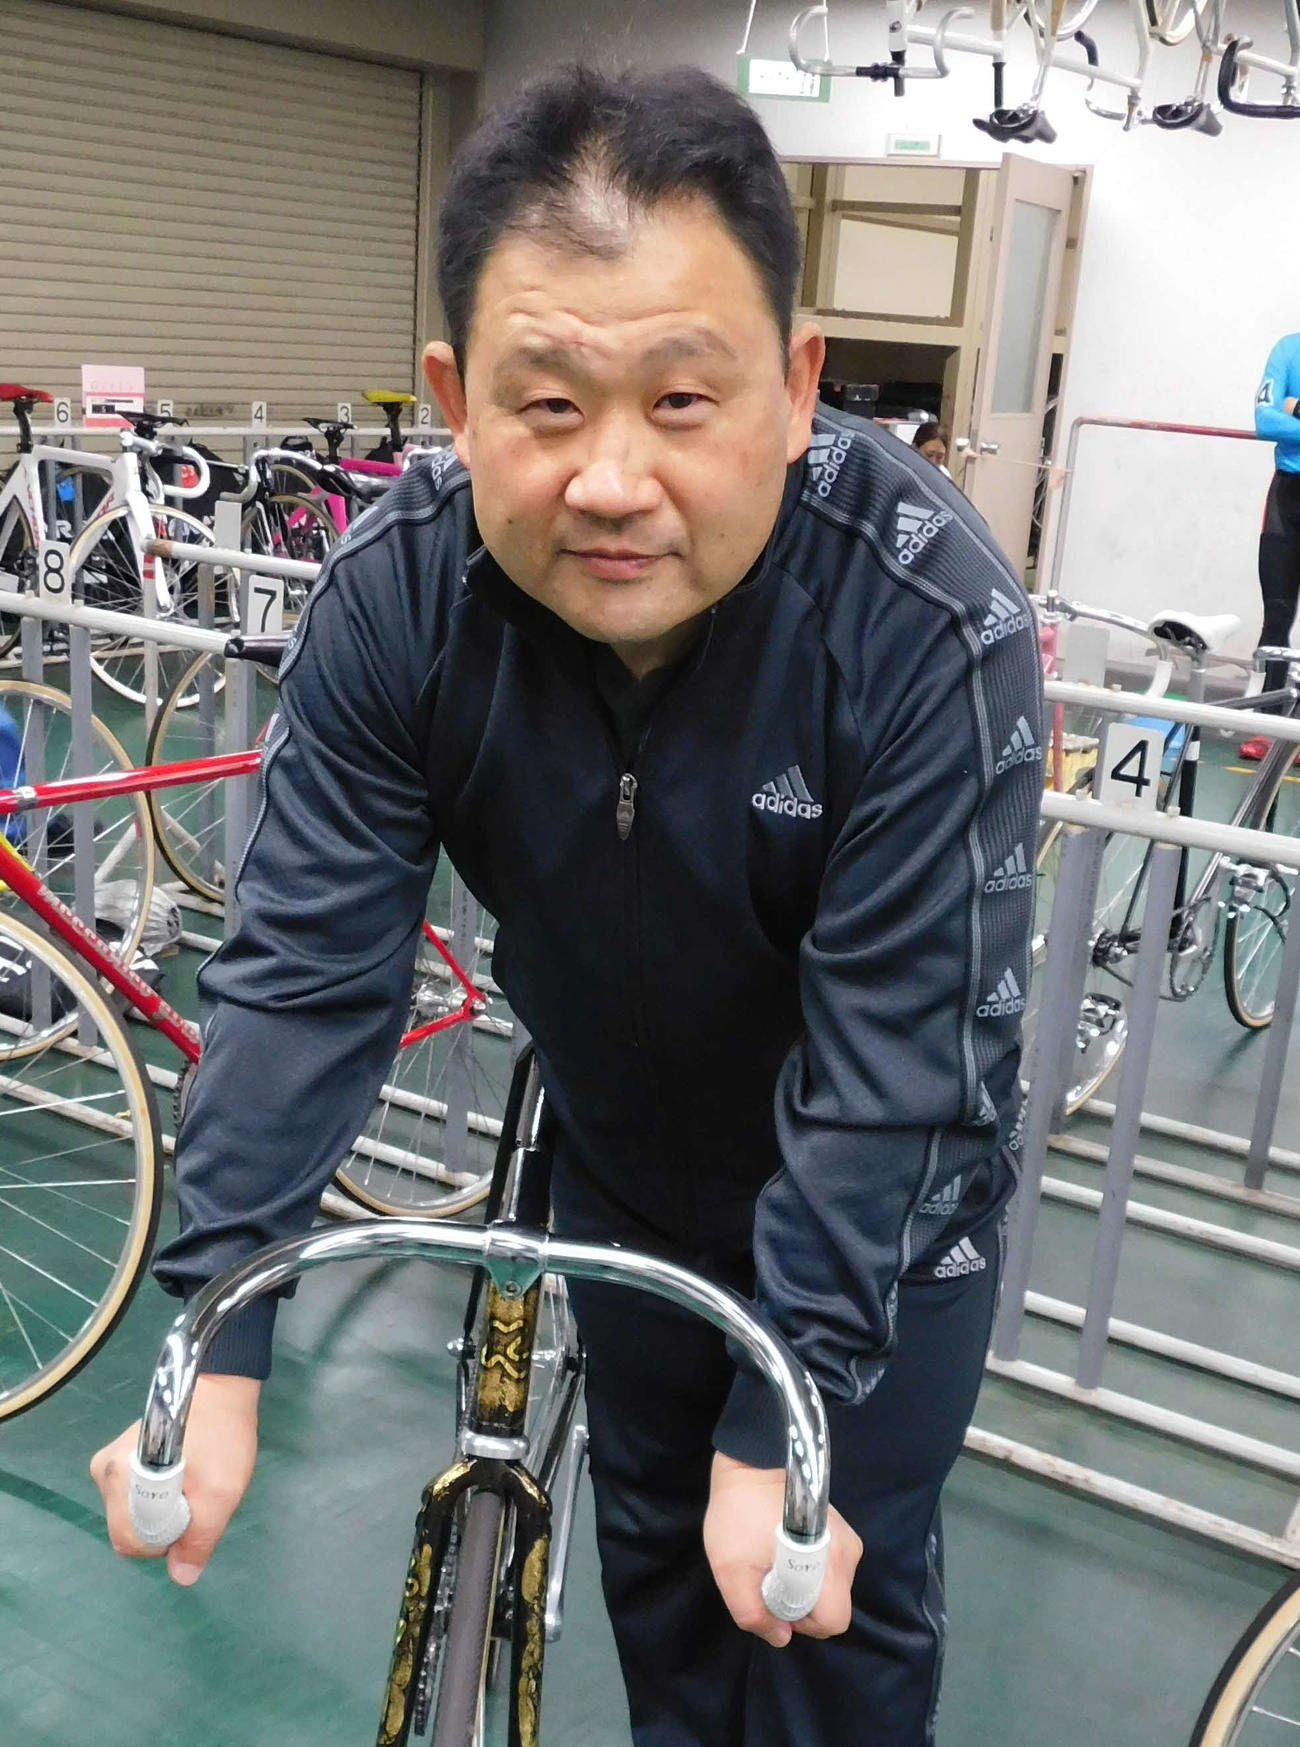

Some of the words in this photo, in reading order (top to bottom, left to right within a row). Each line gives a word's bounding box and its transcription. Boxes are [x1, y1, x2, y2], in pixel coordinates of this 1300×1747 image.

[56, 401, 69, 423] 6
[160, 403, 171, 418] 5
[254, 404, 265, 422] 4
[340, 406, 350, 422] 3
[420, 407, 429, 424] 2
[898, 510, 954, 565] adidas
[43, 549, 65, 594] 8
[253, 586, 277, 633] 7
[995, 742, 1043, 776] adidas
[1110, 739, 1152, 798] 4
[751, 792, 824, 820] adidas
[984, 872, 1033, 894] adidas
[976, 996, 1026, 1019] adidas
[933, 1255, 987, 1280] adidas
